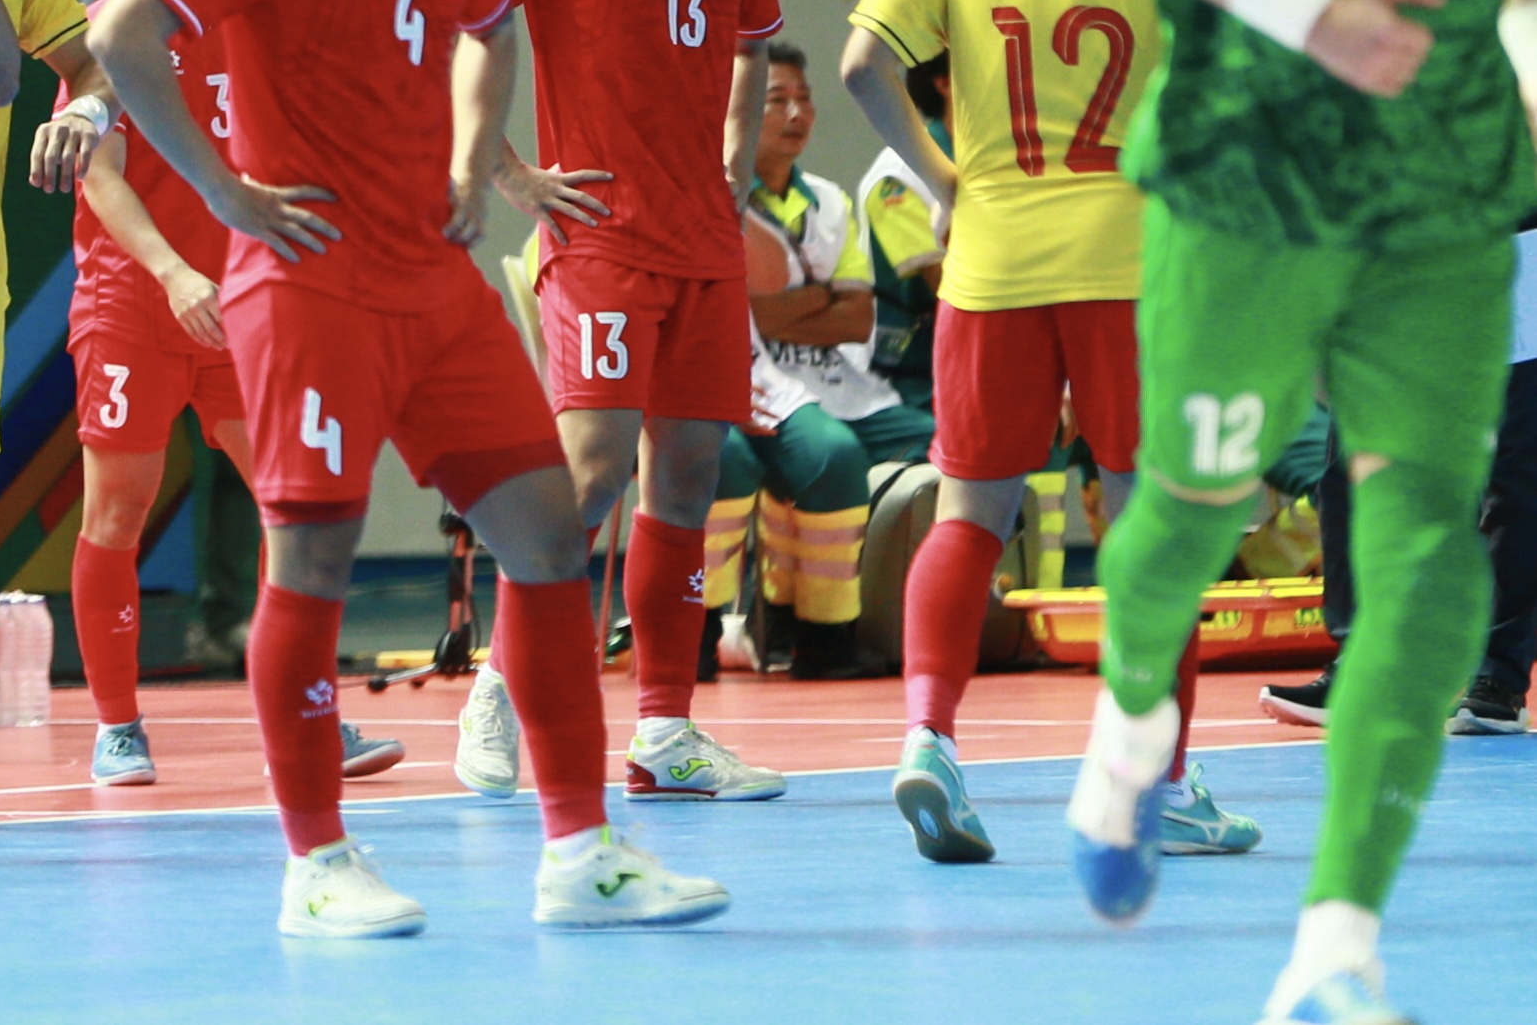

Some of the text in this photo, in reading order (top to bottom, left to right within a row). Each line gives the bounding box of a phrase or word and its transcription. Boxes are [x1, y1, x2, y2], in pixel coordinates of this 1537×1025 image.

[206, 73, 231, 138] 3
[991, 5, 1135, 178] 12
[578, 311, 629, 380] 13
[99, 363, 130, 429] 3
[300, 386, 343, 476] 4
[1182, 391, 1265, 475] 12
